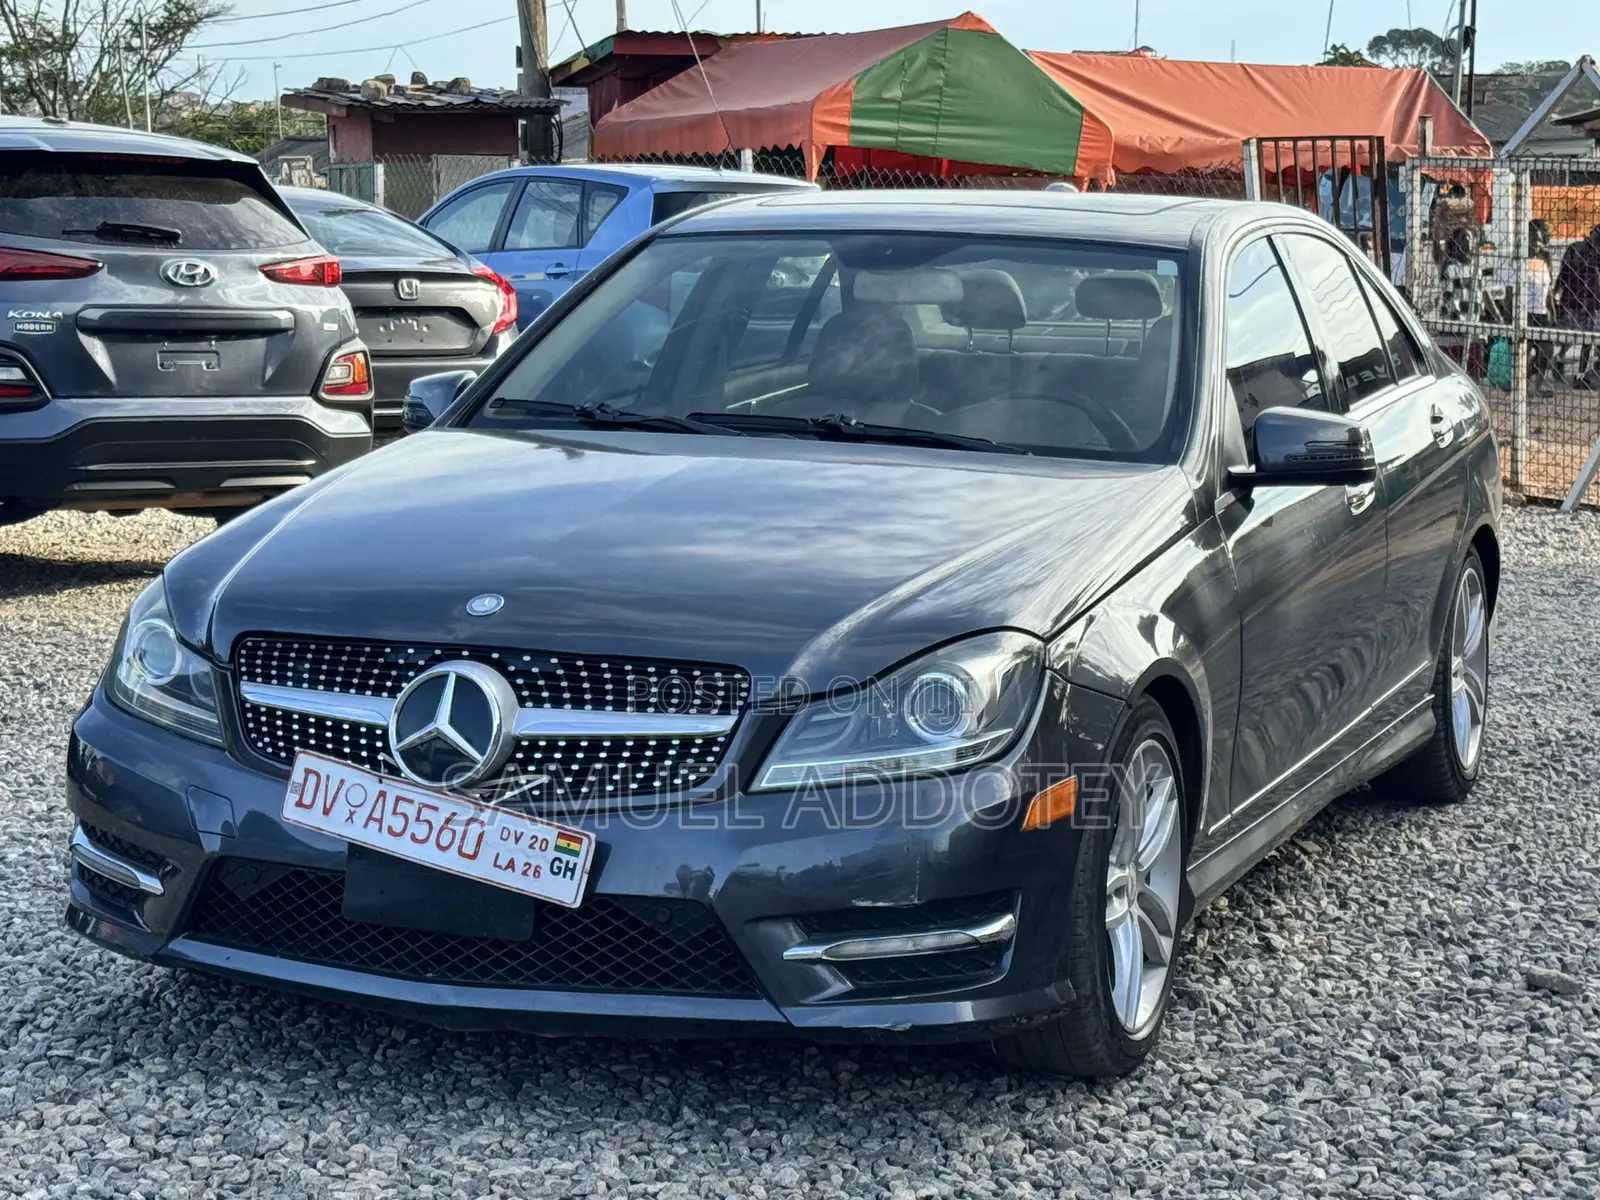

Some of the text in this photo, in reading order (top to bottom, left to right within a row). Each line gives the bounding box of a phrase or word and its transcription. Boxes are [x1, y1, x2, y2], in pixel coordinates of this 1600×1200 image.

[7, 309, 64, 319] KONA
[16, 323, 53, 331] MODERN
[294, 767, 345, 817] DV
[363, 790, 486, 861] A5560
[500, 826, 549, 852] DV 20
[493, 852, 542, 879] LA 26
[549, 856, 578, 881] GH
